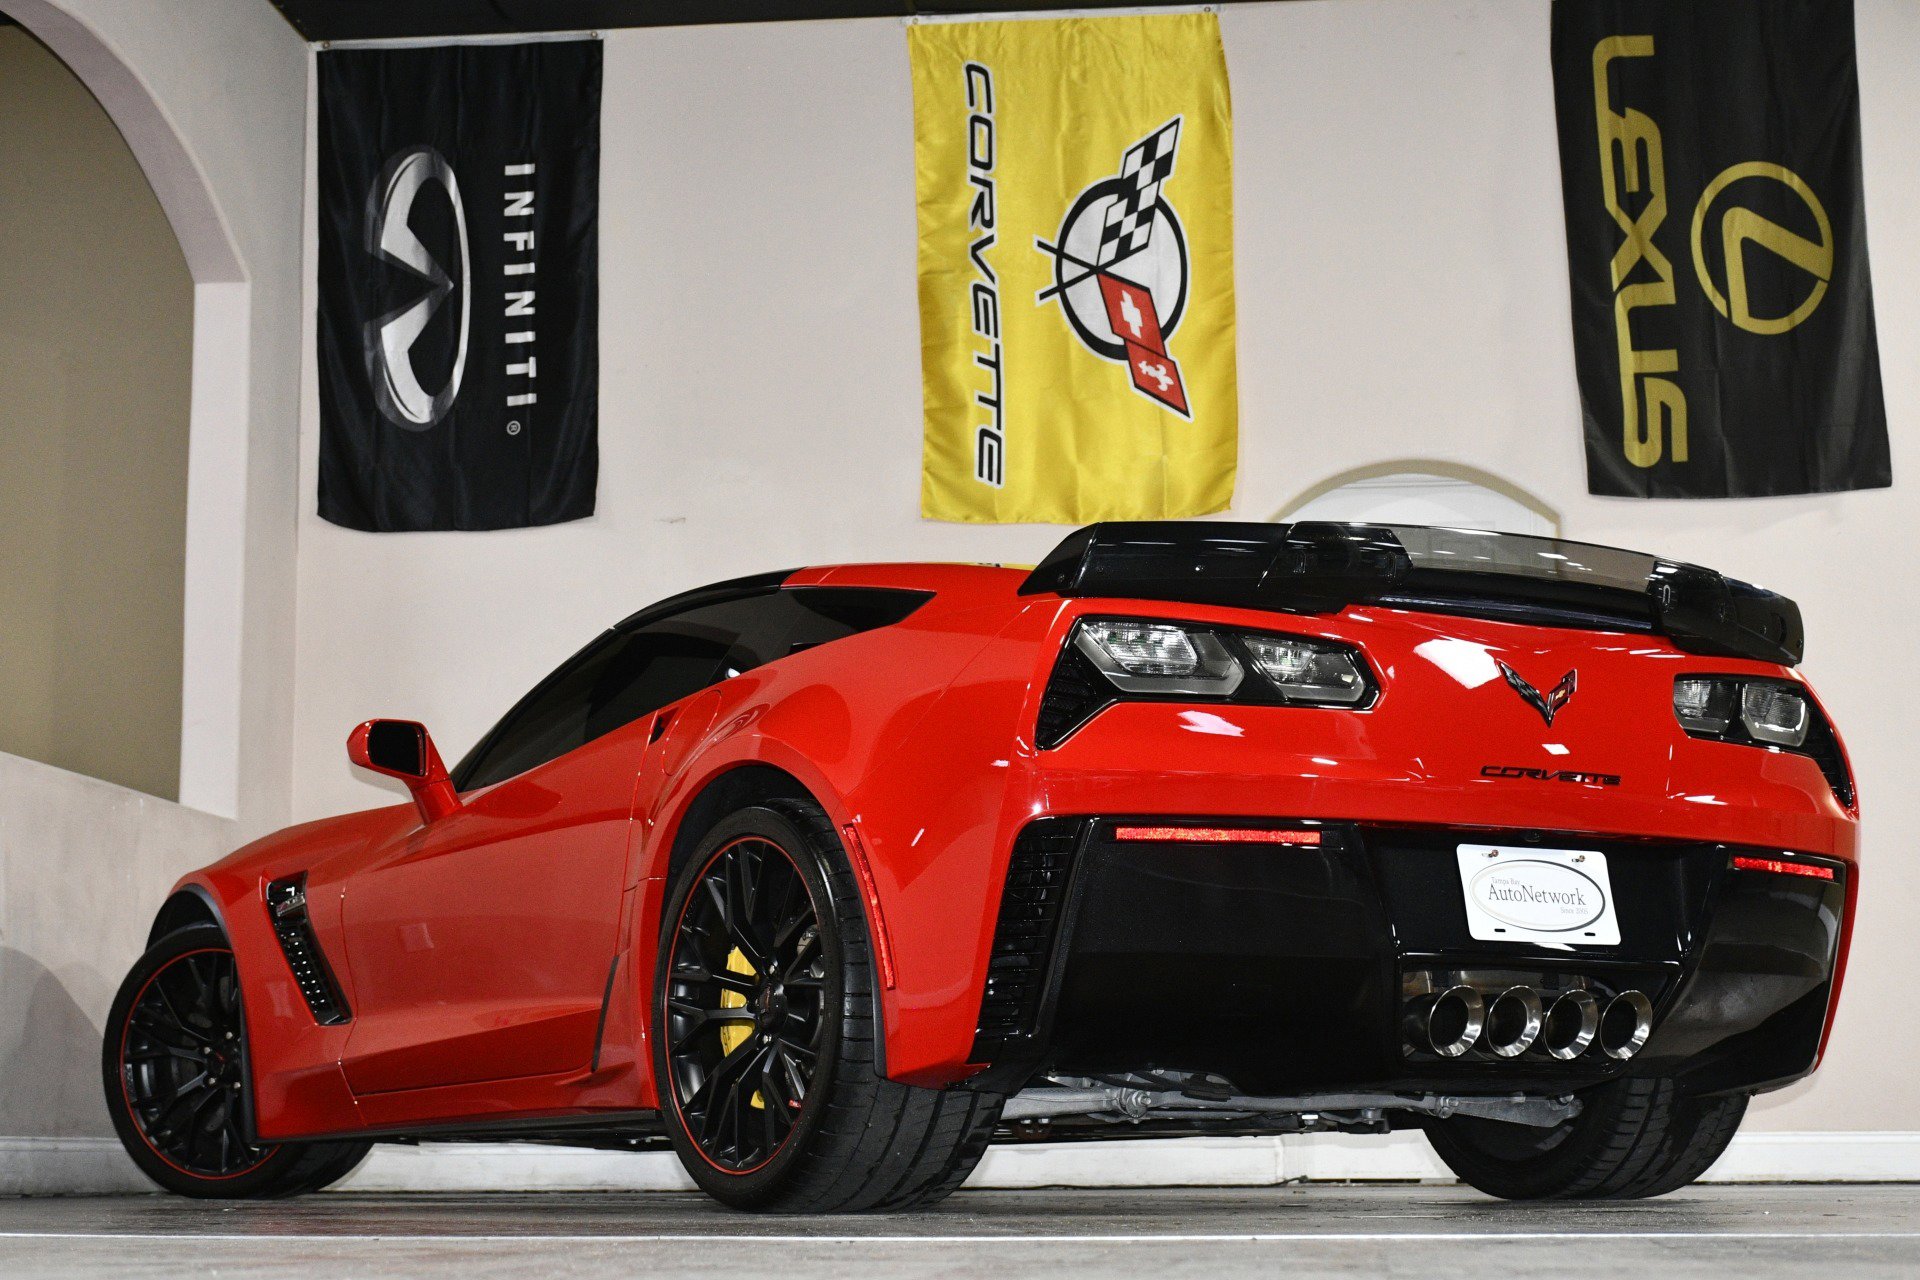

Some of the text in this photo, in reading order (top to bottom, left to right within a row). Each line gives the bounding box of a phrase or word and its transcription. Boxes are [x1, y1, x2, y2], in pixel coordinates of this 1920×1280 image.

[504, 163, 537, 407] INFINITI
[963, 61, 1004, 487] CORVETTE
[1592, 35, 1688, 468] LEXUS
[1480, 765, 1621, 786] CORVETTE
[1488, 884, 1587, 906] AutoNetwork
[1491, 877, 1520, 886] Tampa Bay
